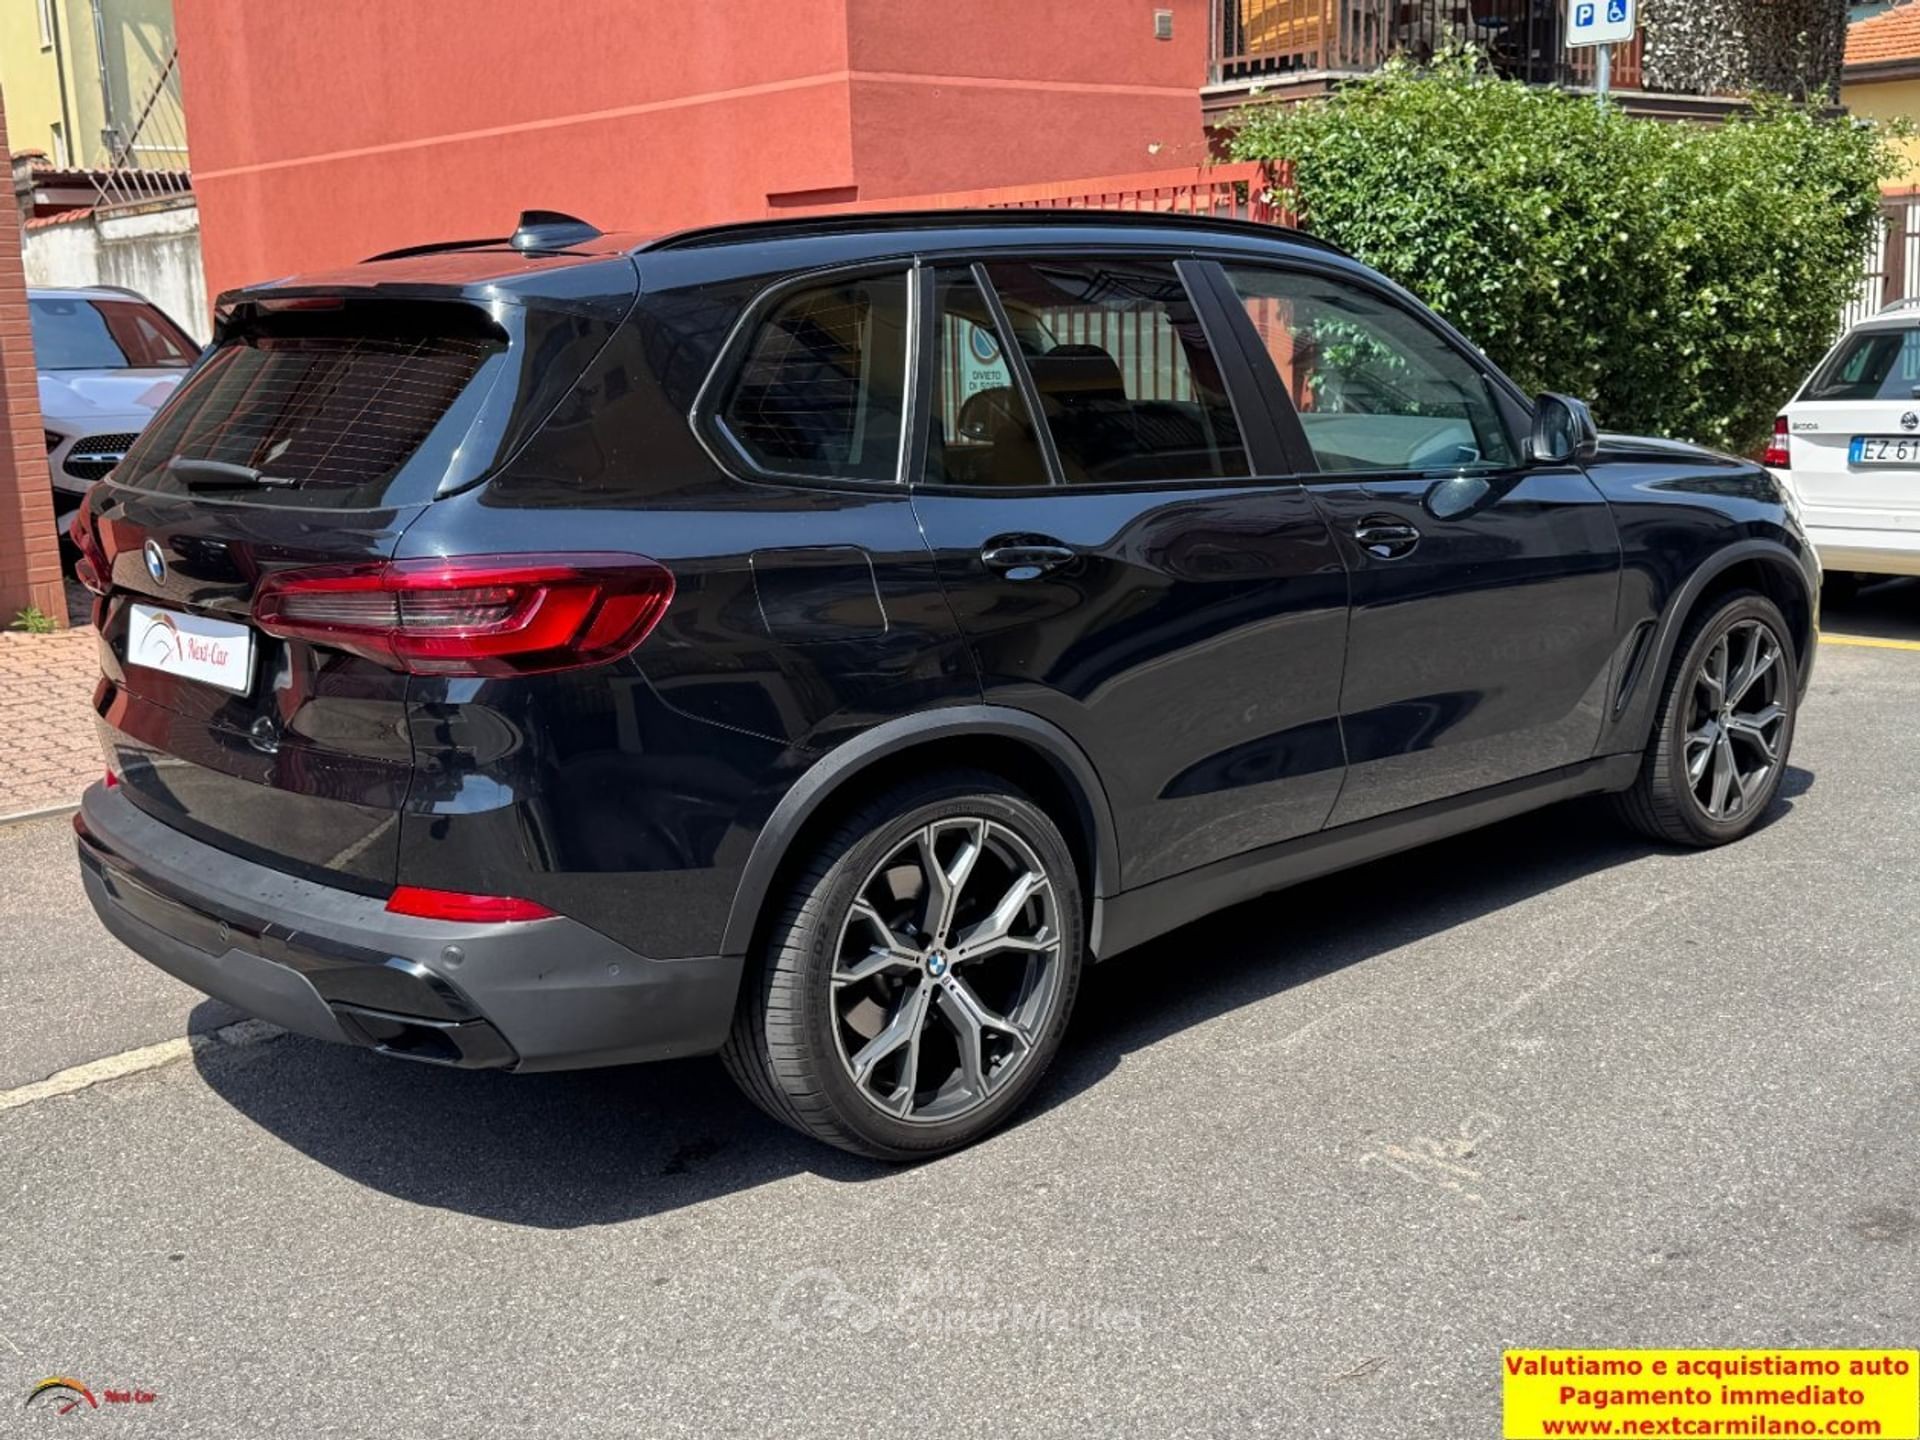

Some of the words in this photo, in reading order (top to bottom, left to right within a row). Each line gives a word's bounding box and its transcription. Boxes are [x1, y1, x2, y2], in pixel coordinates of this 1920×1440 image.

[1579, 6, 1592, 26] P
[972, 370, 1001, 380] DIVIETO
[188, 637, 229, 665] Next-Car
